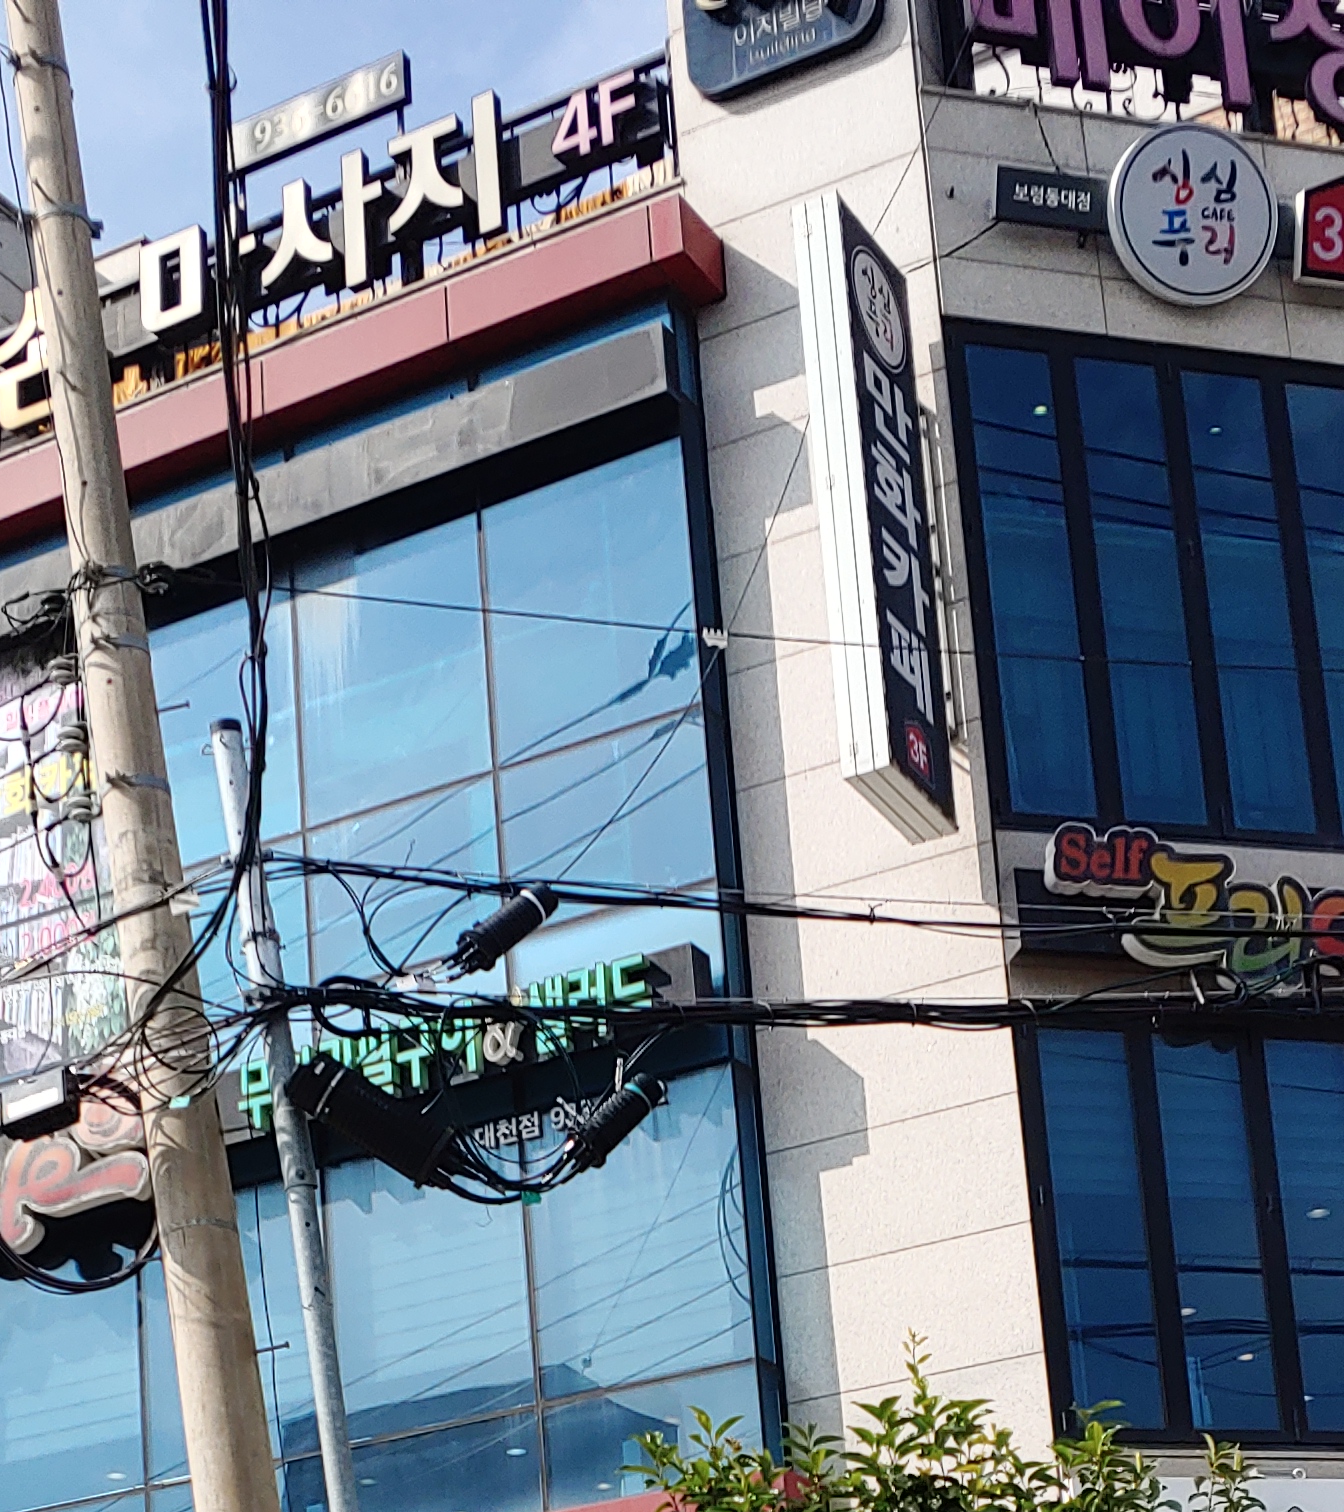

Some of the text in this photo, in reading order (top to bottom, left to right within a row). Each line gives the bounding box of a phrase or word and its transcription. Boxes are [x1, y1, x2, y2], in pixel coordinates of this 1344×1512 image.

[140, 89, 503, 331] 마사지
[552, 70, 637, 157] 4F
[1201, 206, 1236, 223] CAFE
[864, 350, 935, 727] 만화카페
[1059, 832, 1150, 882] Self
[473, 1111, 541, 1150] 대천점
